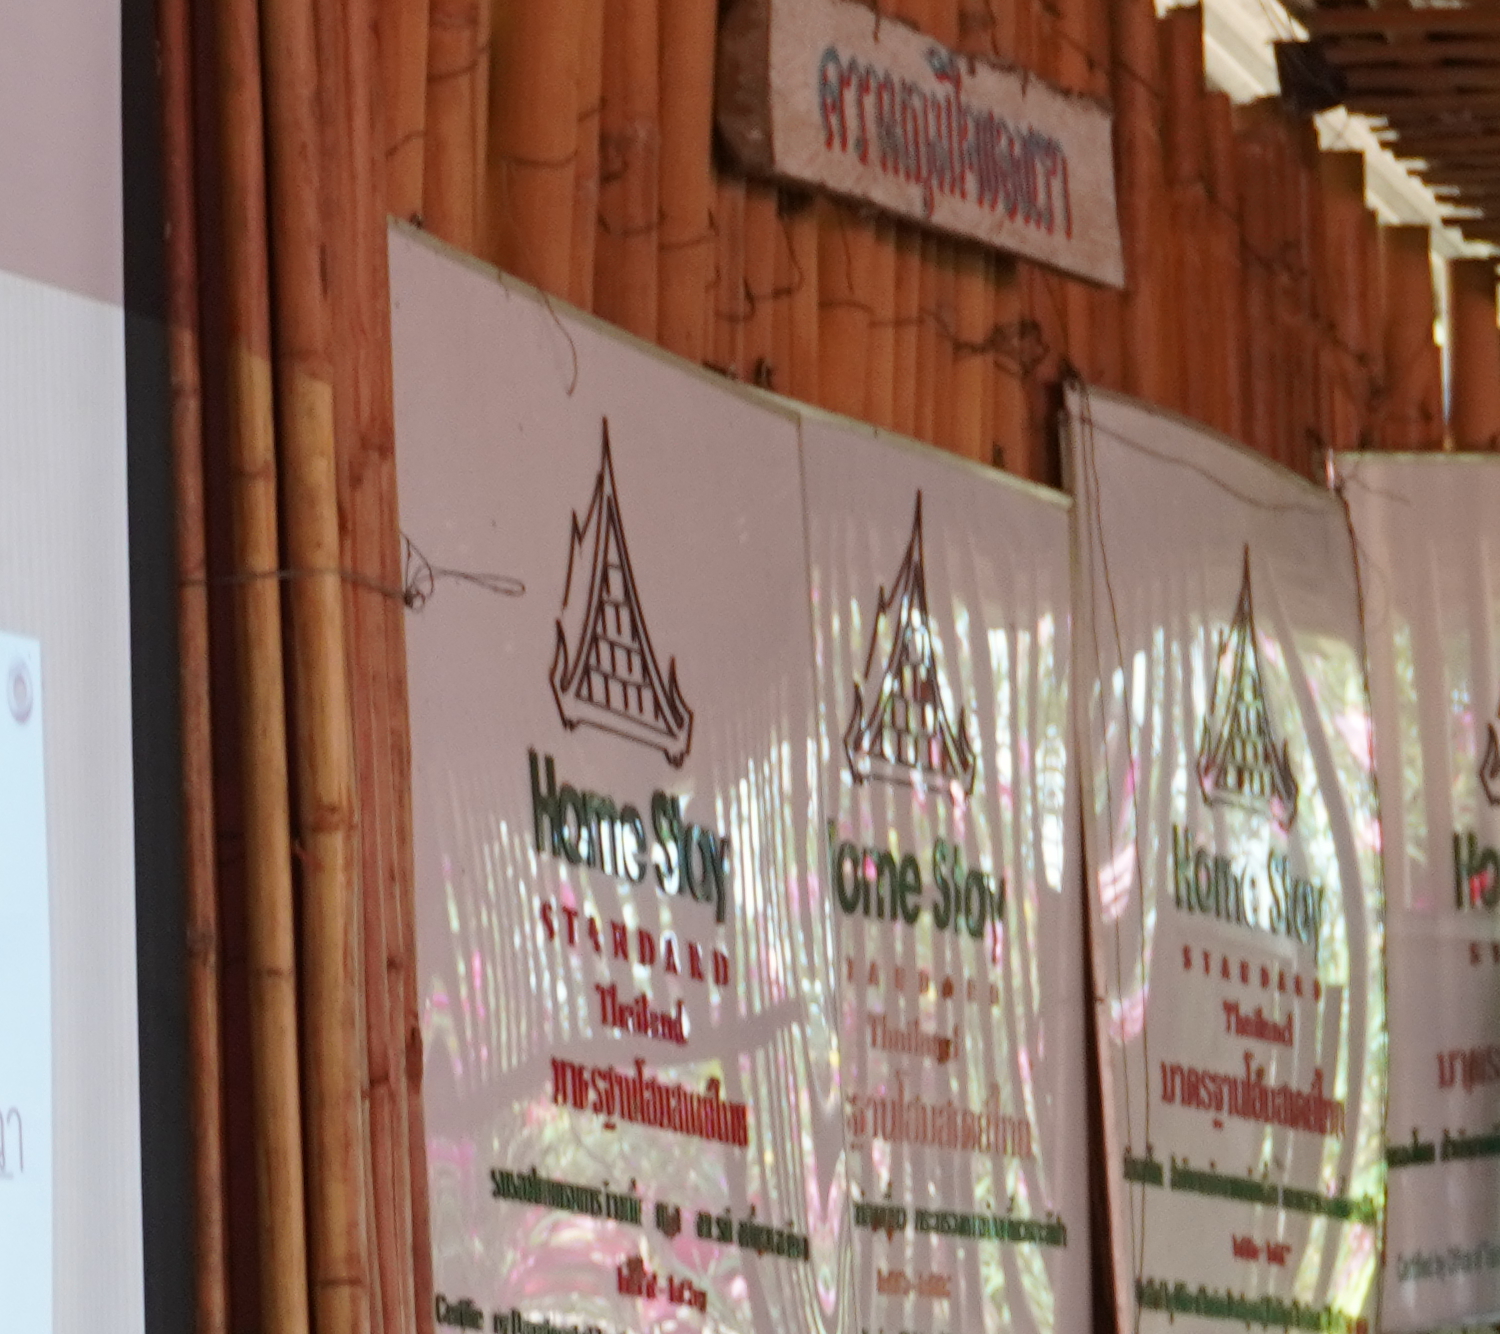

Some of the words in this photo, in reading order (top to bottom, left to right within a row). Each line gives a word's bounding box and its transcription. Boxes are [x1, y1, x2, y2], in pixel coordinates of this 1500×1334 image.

[529, 746, 647, 884] Home
[540, 900, 731, 987] STANDARD
[595, 982, 690, 1045] Thailand
